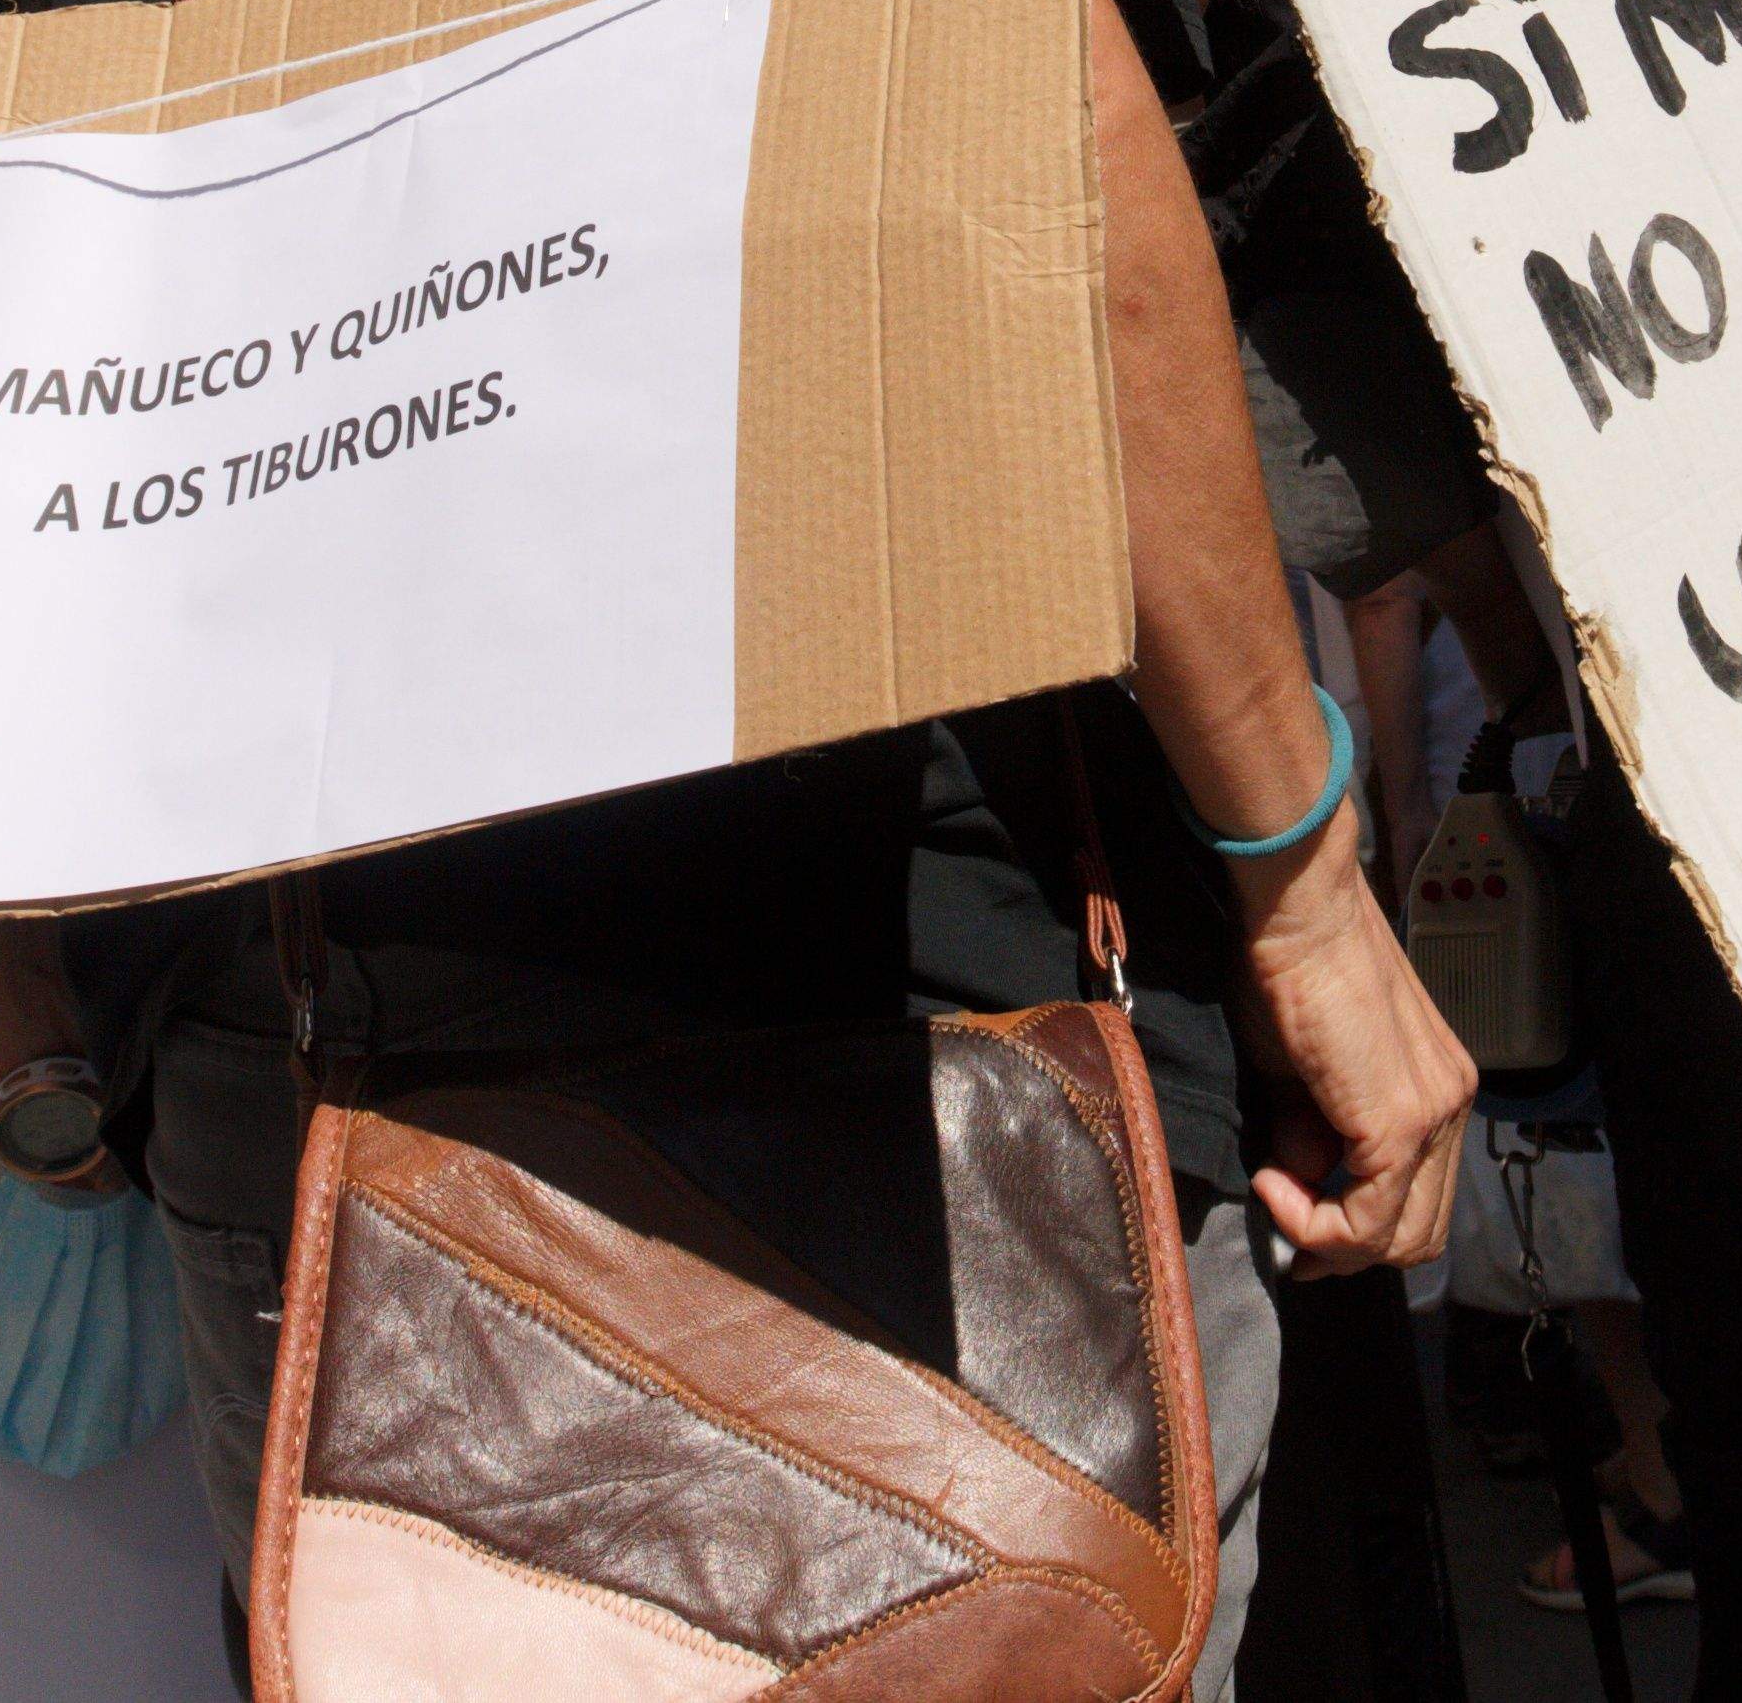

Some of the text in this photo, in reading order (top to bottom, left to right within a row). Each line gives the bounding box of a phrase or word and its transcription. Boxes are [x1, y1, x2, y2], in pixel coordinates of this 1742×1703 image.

[290, 325, 319, 375] Y
[330, 223, 611, 361] QUIÑONES,
[1522, 211, 1728, 433] NO
[33, 370, 518, 533] A LOS TIBURONES.
